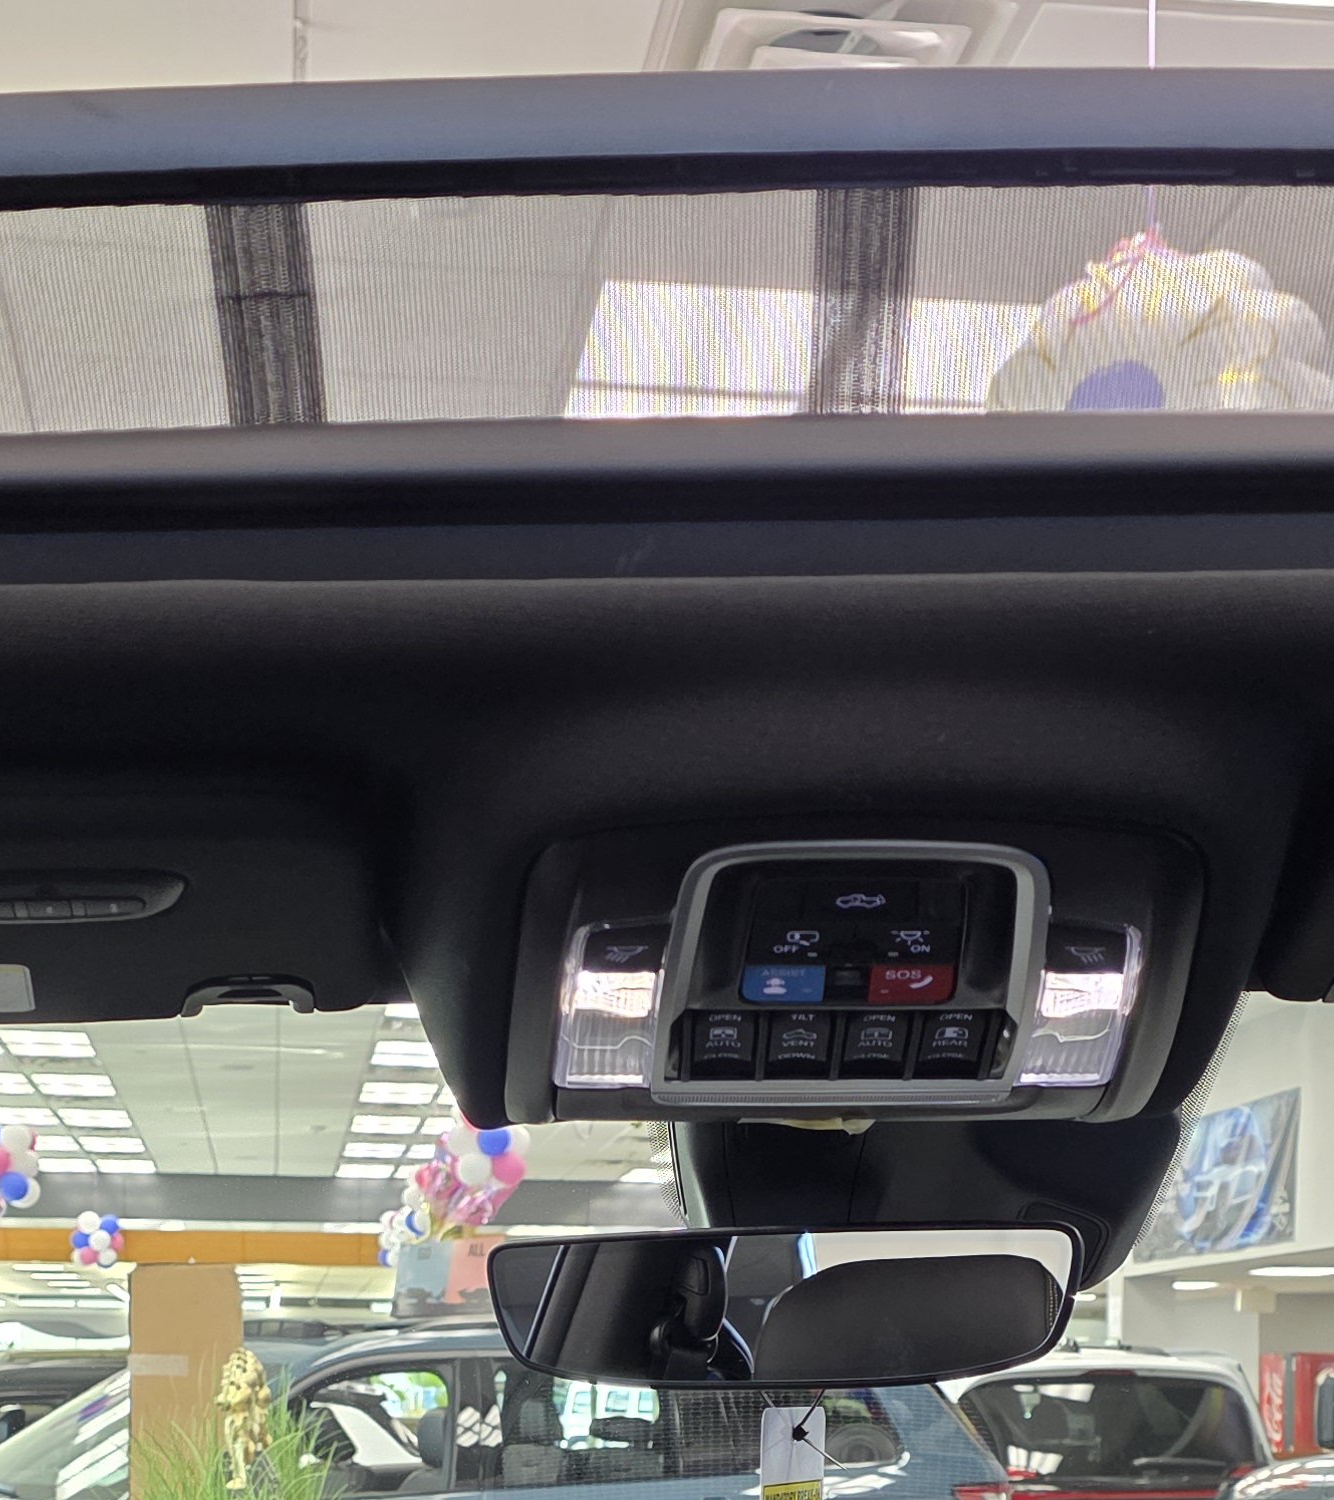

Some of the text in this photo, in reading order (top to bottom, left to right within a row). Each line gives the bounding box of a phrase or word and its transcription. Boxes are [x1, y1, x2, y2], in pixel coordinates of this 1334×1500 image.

[773, 945, 799, 954] OFF
[910, 944, 931, 954] ON
[761, 968, 805, 977] ASSIST
[884, 969, 922, 980] SOS
[708, 1013, 742, 1023] OPEN
[790, 1013, 816, 1022] TILT
[863, 1013, 896, 1023] OPEN
[939, 1012, 973, 1022] OPEN
[782, 1039, 816, 1048] VENT
